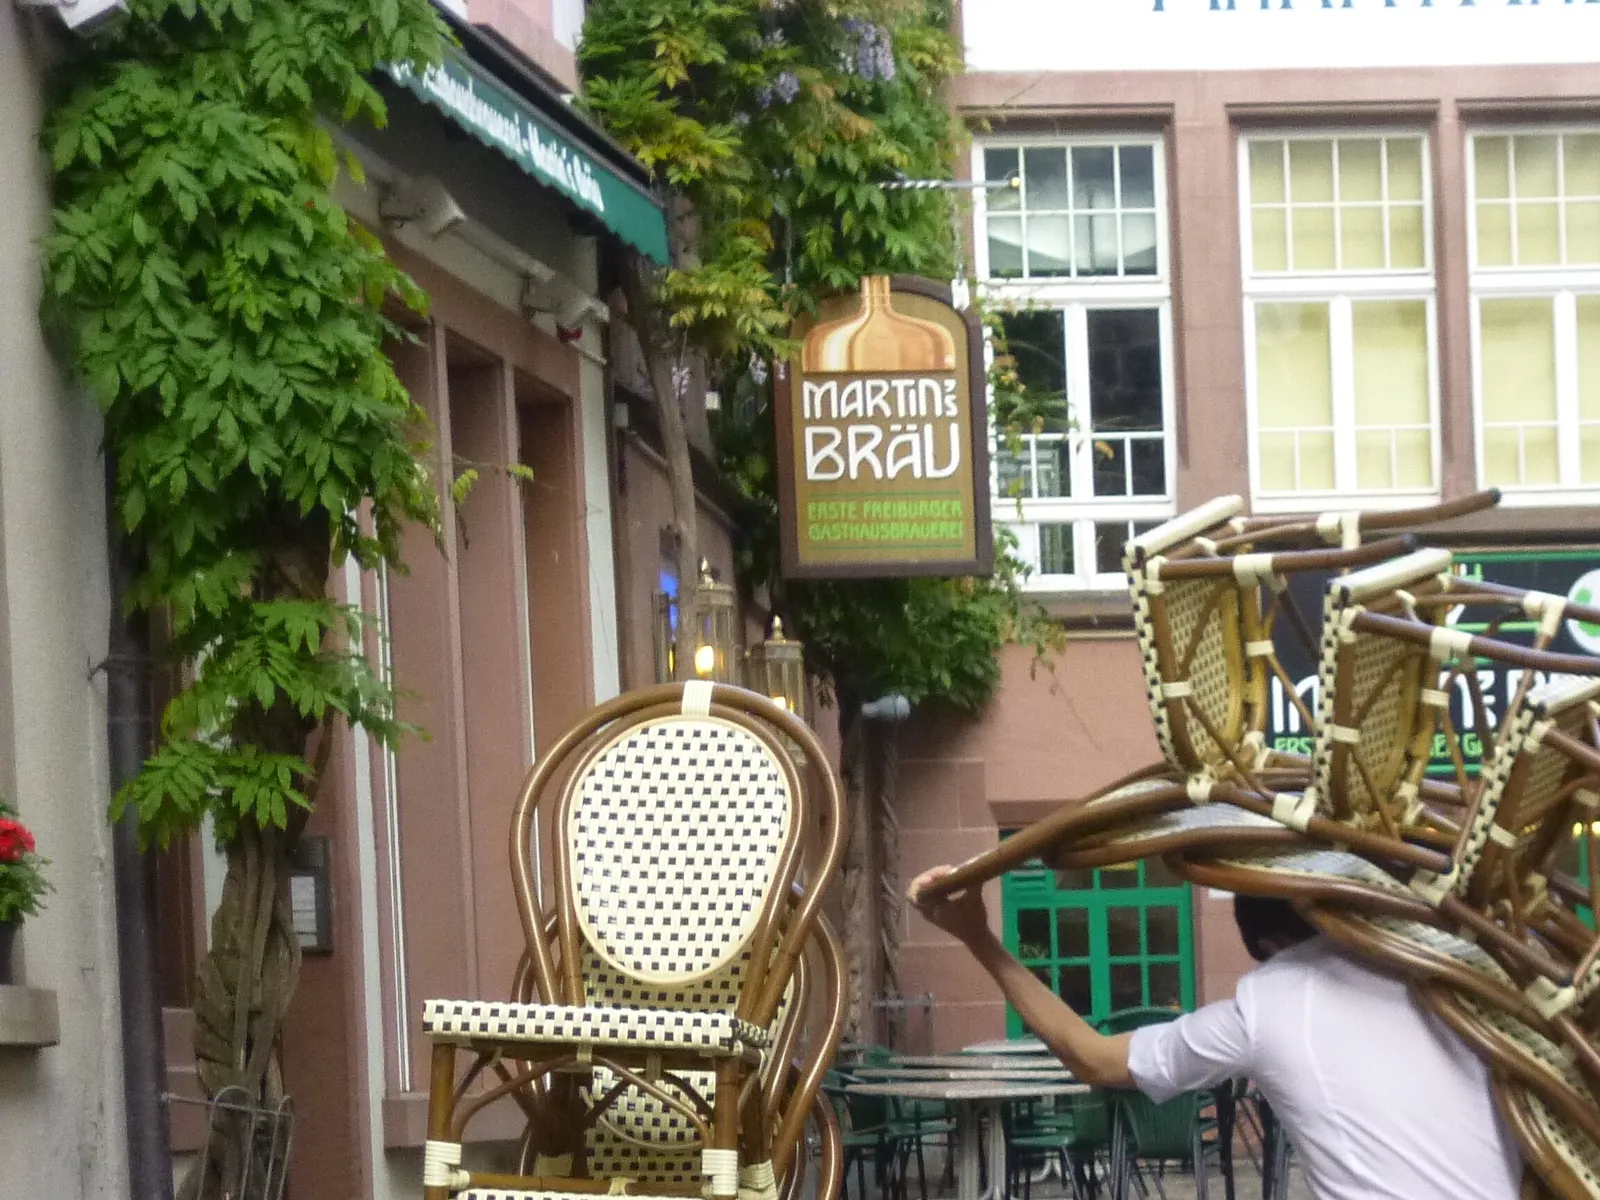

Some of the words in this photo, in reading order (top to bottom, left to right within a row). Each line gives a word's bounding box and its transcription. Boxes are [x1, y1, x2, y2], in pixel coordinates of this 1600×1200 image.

[805, 422, 961, 481] BRÄU
[808, 501, 858, 520] ERSTE
[863, 499, 963, 519] FREIBURGER
[808, 519, 964, 541] GASTHAUSBRAUEREI
